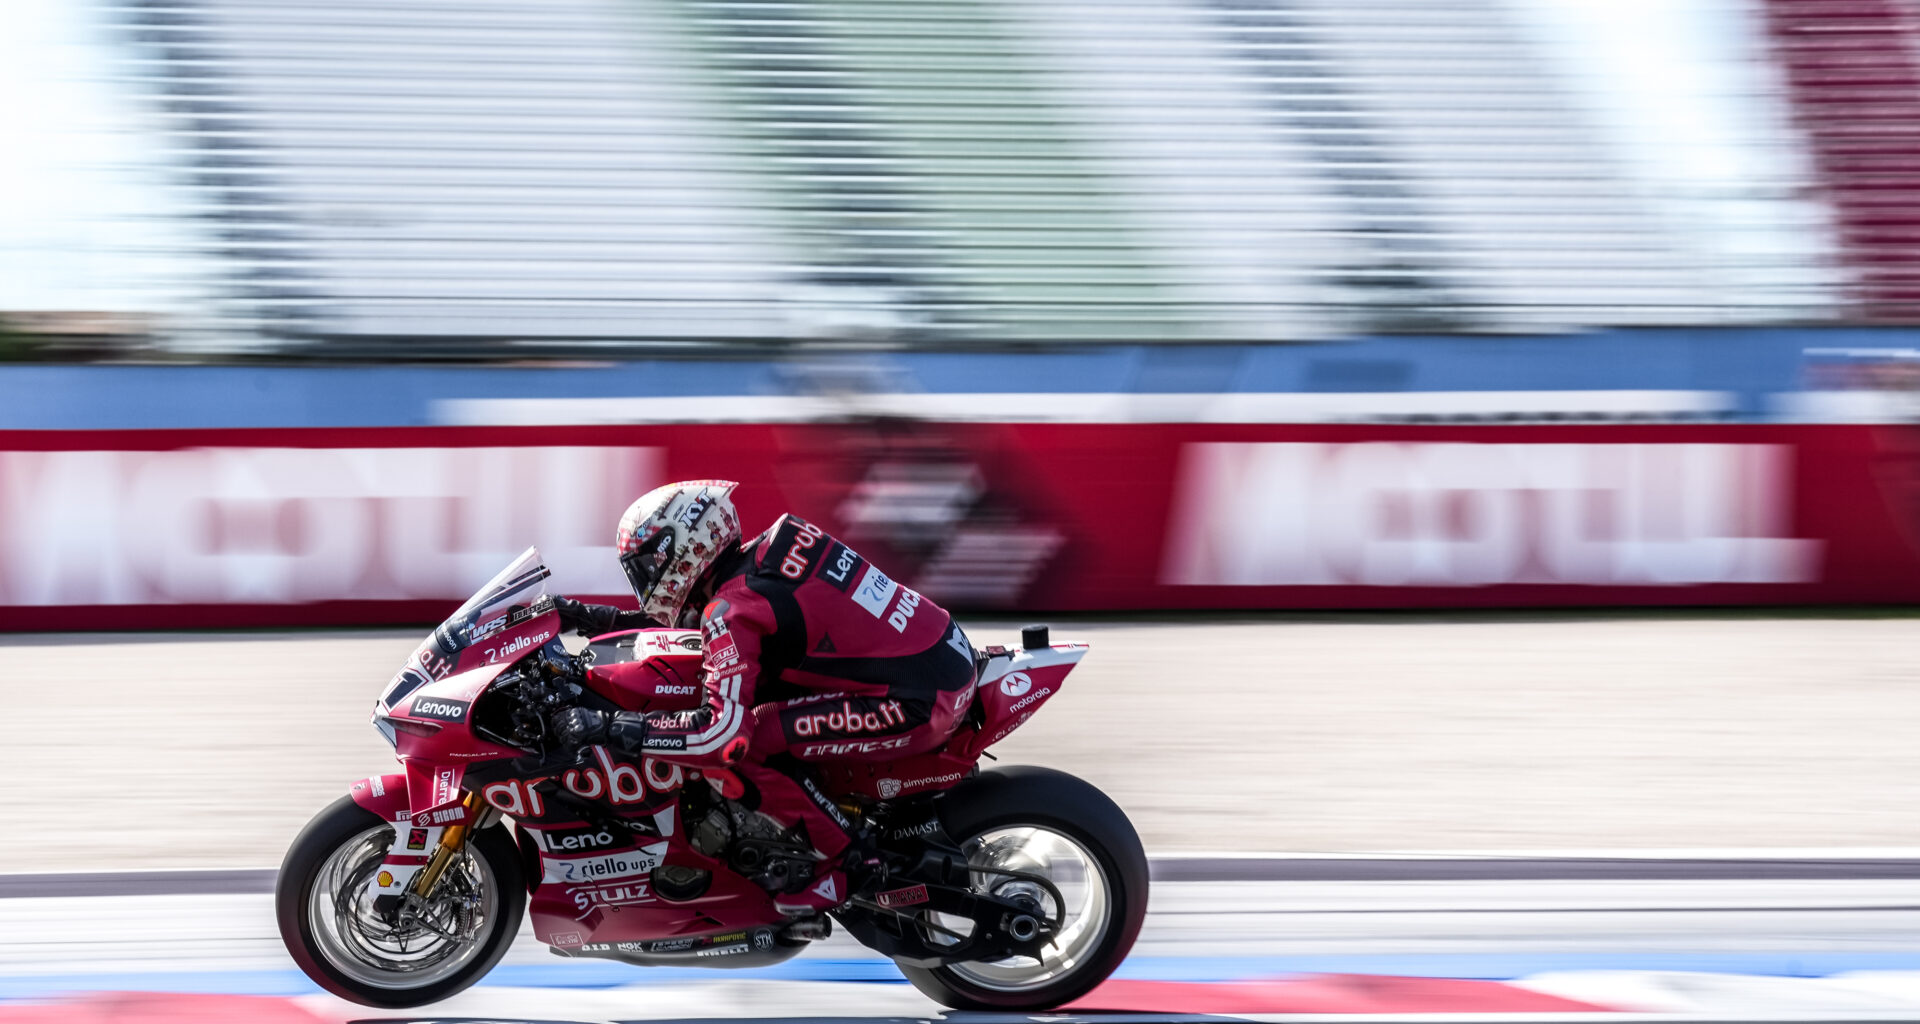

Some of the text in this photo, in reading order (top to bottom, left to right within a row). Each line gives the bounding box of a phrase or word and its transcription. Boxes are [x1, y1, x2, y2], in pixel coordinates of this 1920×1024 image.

[678, 487, 712, 527] KYT
[472, 614, 508, 639] WRS
[499, 630, 551, 658] riello ups
[720, 662, 748, 677] motorola
[414, 698, 462, 718] Lenovo
[1009, 687, 1051, 713] motorola
[794, 700, 907, 737] aruba.it
[642, 736, 683, 748] Lenovo
[903, 772, 962, 789] simyousoon
[893, 822, 939, 840] DAMAST
[582, 857, 656, 877] riello ups
[574, 885, 650, 910] STULZ
[879, 887, 924, 906] UMANA
[617, 942, 642, 951] NGK
[755, 933, 773, 946] STM
